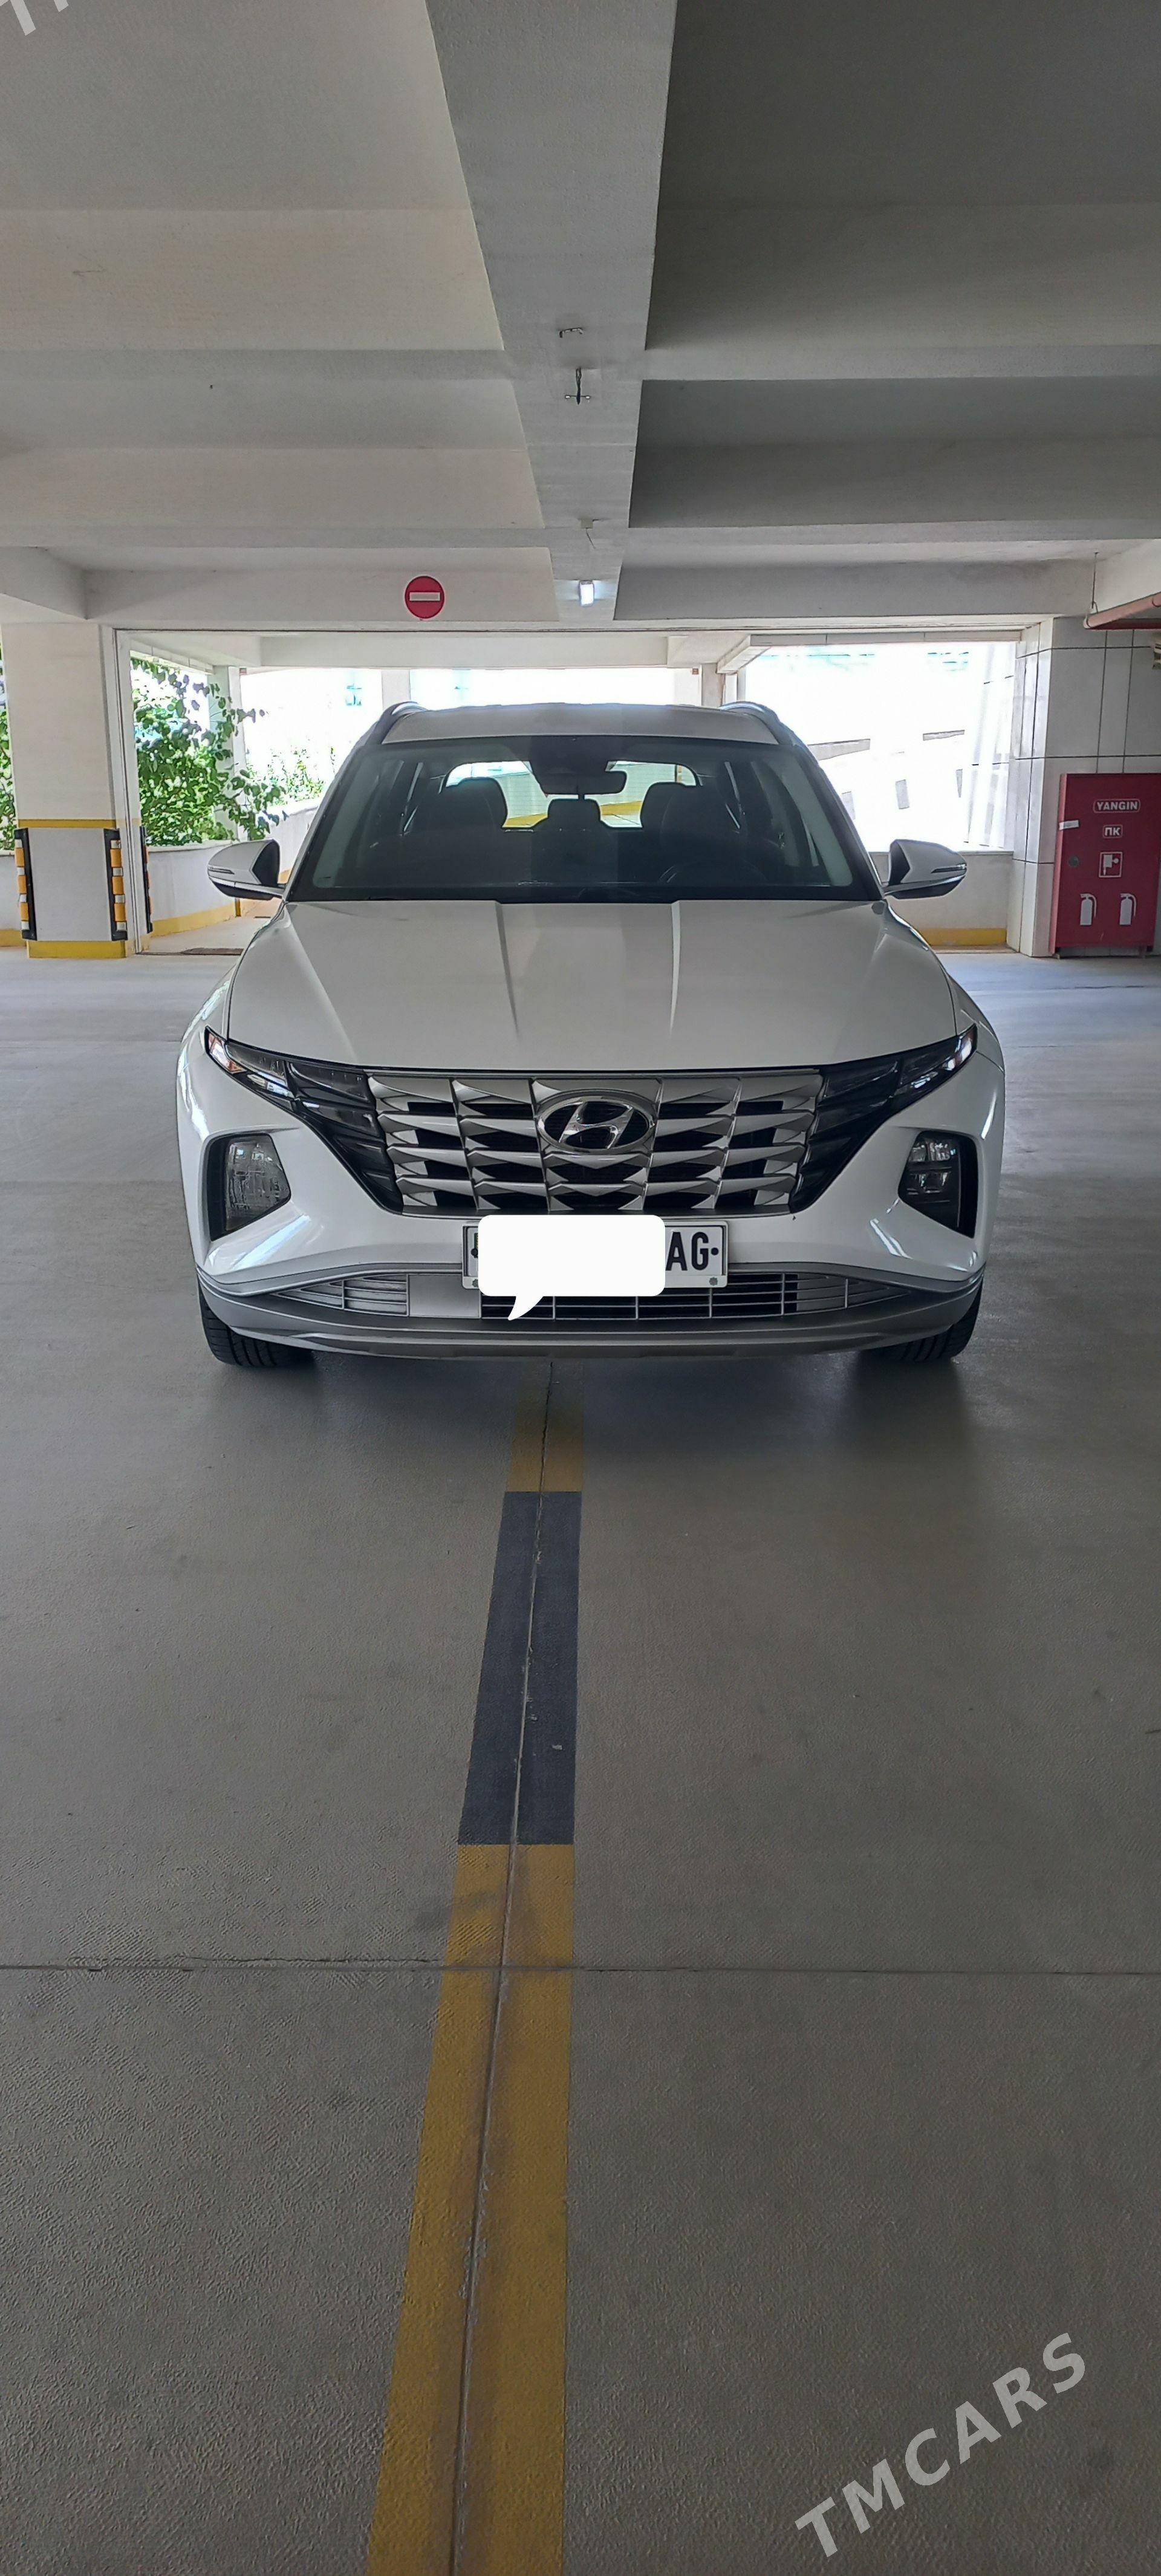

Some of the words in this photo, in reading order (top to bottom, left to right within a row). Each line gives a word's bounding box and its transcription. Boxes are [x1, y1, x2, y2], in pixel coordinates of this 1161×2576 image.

[1096, 801, 1138, 811] YANGIN
[1104, 827, 1120, 836] ПК
[665, 1231, 709, 1271] AG
